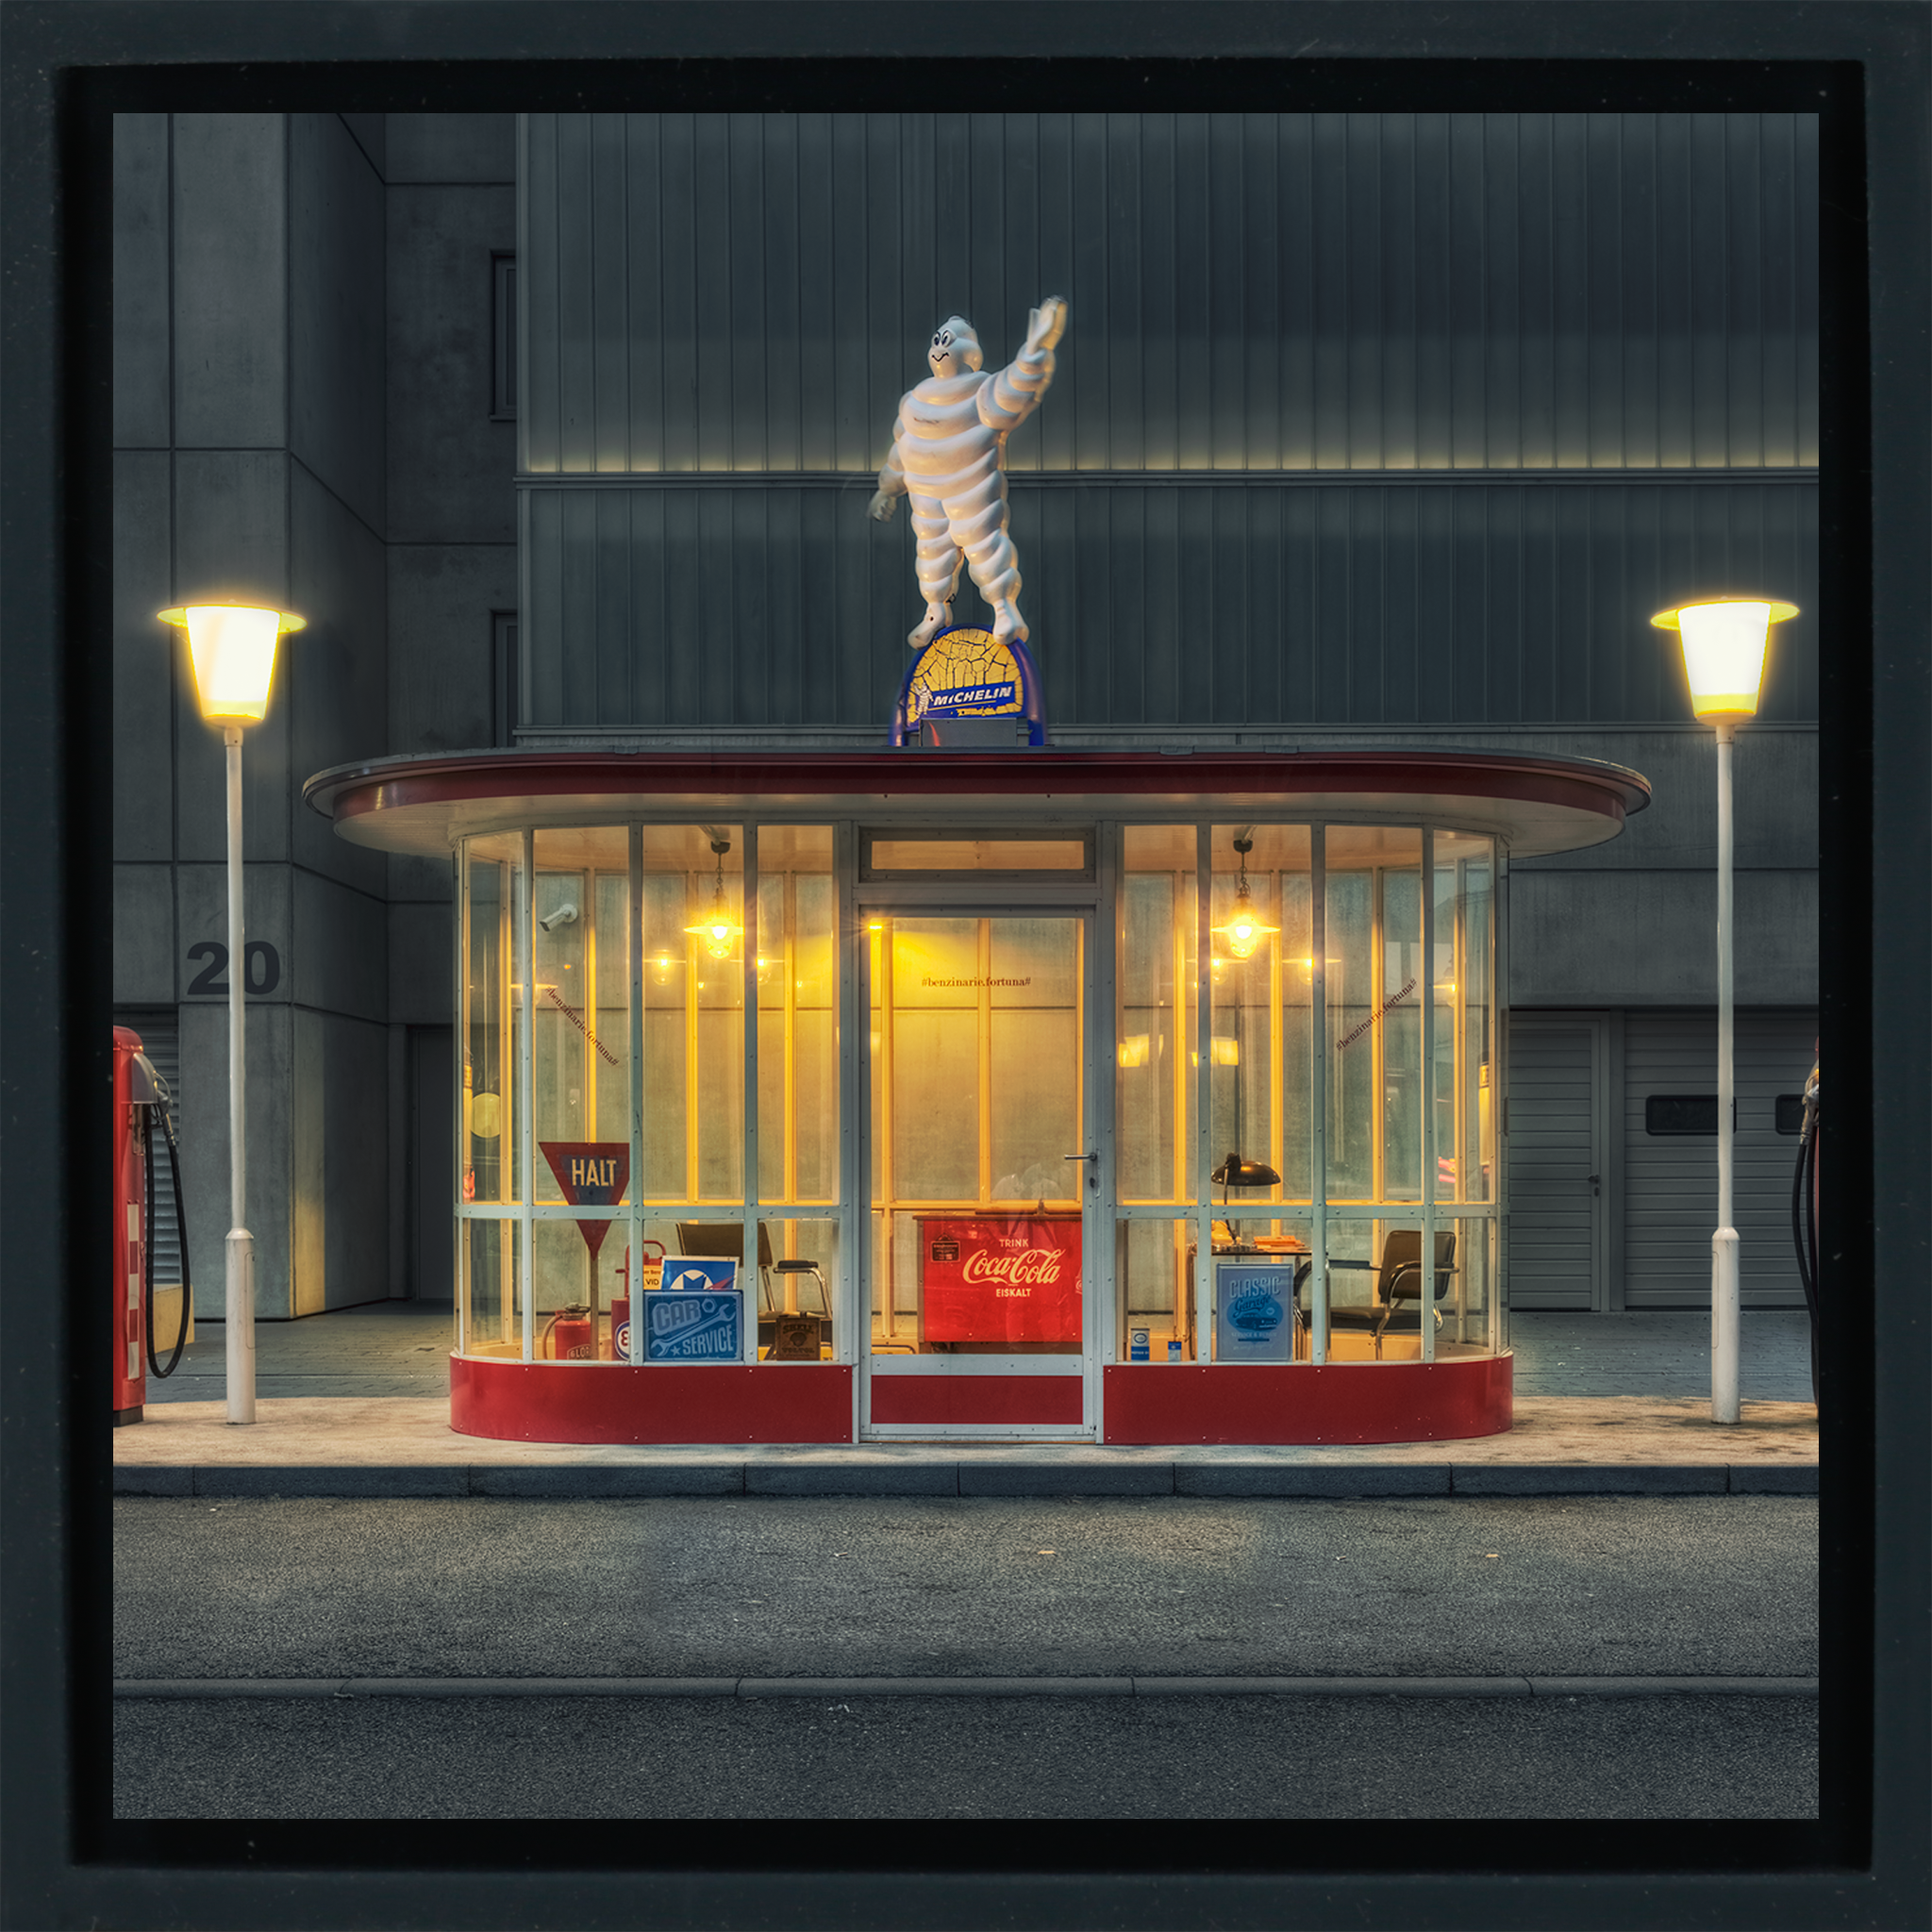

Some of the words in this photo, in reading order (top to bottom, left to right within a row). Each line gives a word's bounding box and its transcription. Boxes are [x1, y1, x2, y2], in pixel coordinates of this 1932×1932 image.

[933, 686, 1012, 706] MICHELIN
[187, 941, 280, 995] 20
[922, 976, 1031, 987] #benzinarie.fortuna#
[572, 1159, 617, 1187] HALT
[999, 1239, 1029, 1247] TRINK
[962, 1249, 1066, 1284] Coca-Cola
[996, 1289, 1032, 1297] EISKALT
[1229, 1275, 1281, 1299] CLASSIC
[653, 1300, 701, 1336] CAR
[682, 1324, 734, 1356] SERVICE
